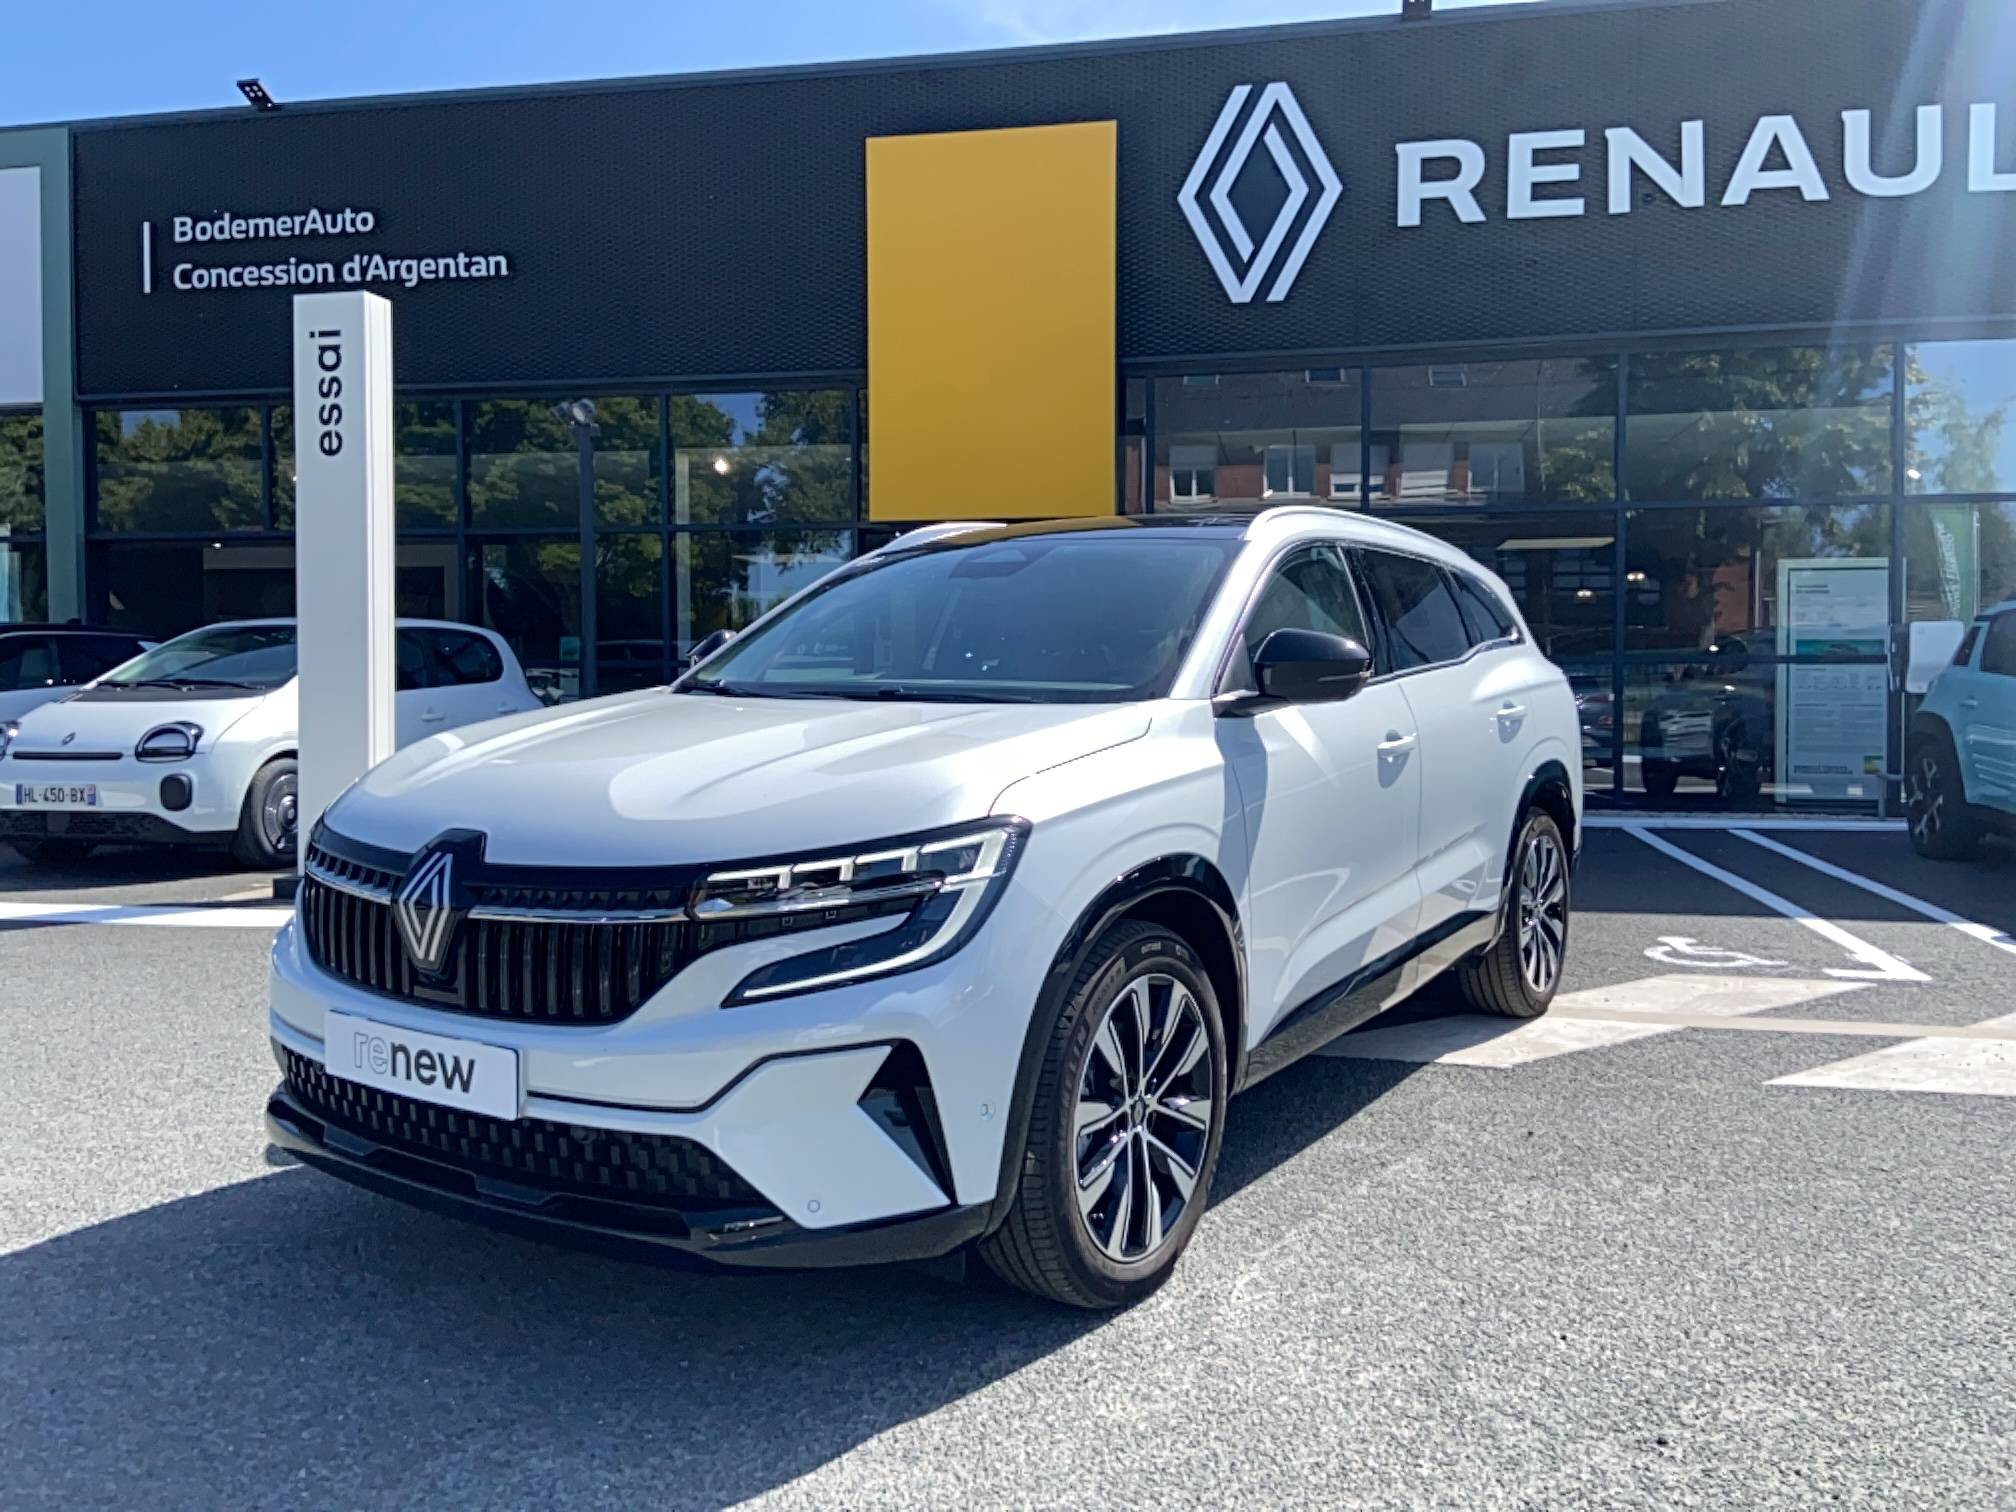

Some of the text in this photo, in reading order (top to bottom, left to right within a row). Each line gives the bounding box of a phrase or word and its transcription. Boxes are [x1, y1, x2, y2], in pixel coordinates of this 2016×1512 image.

[1395, 102, 2016, 227] RENAUL
[173, 208, 375, 243] BodemerAuto
[173, 252, 509, 290] Concession d'Argentan
[309, 328, 343, 457] essai
[354, 1031, 476, 1094] renew
